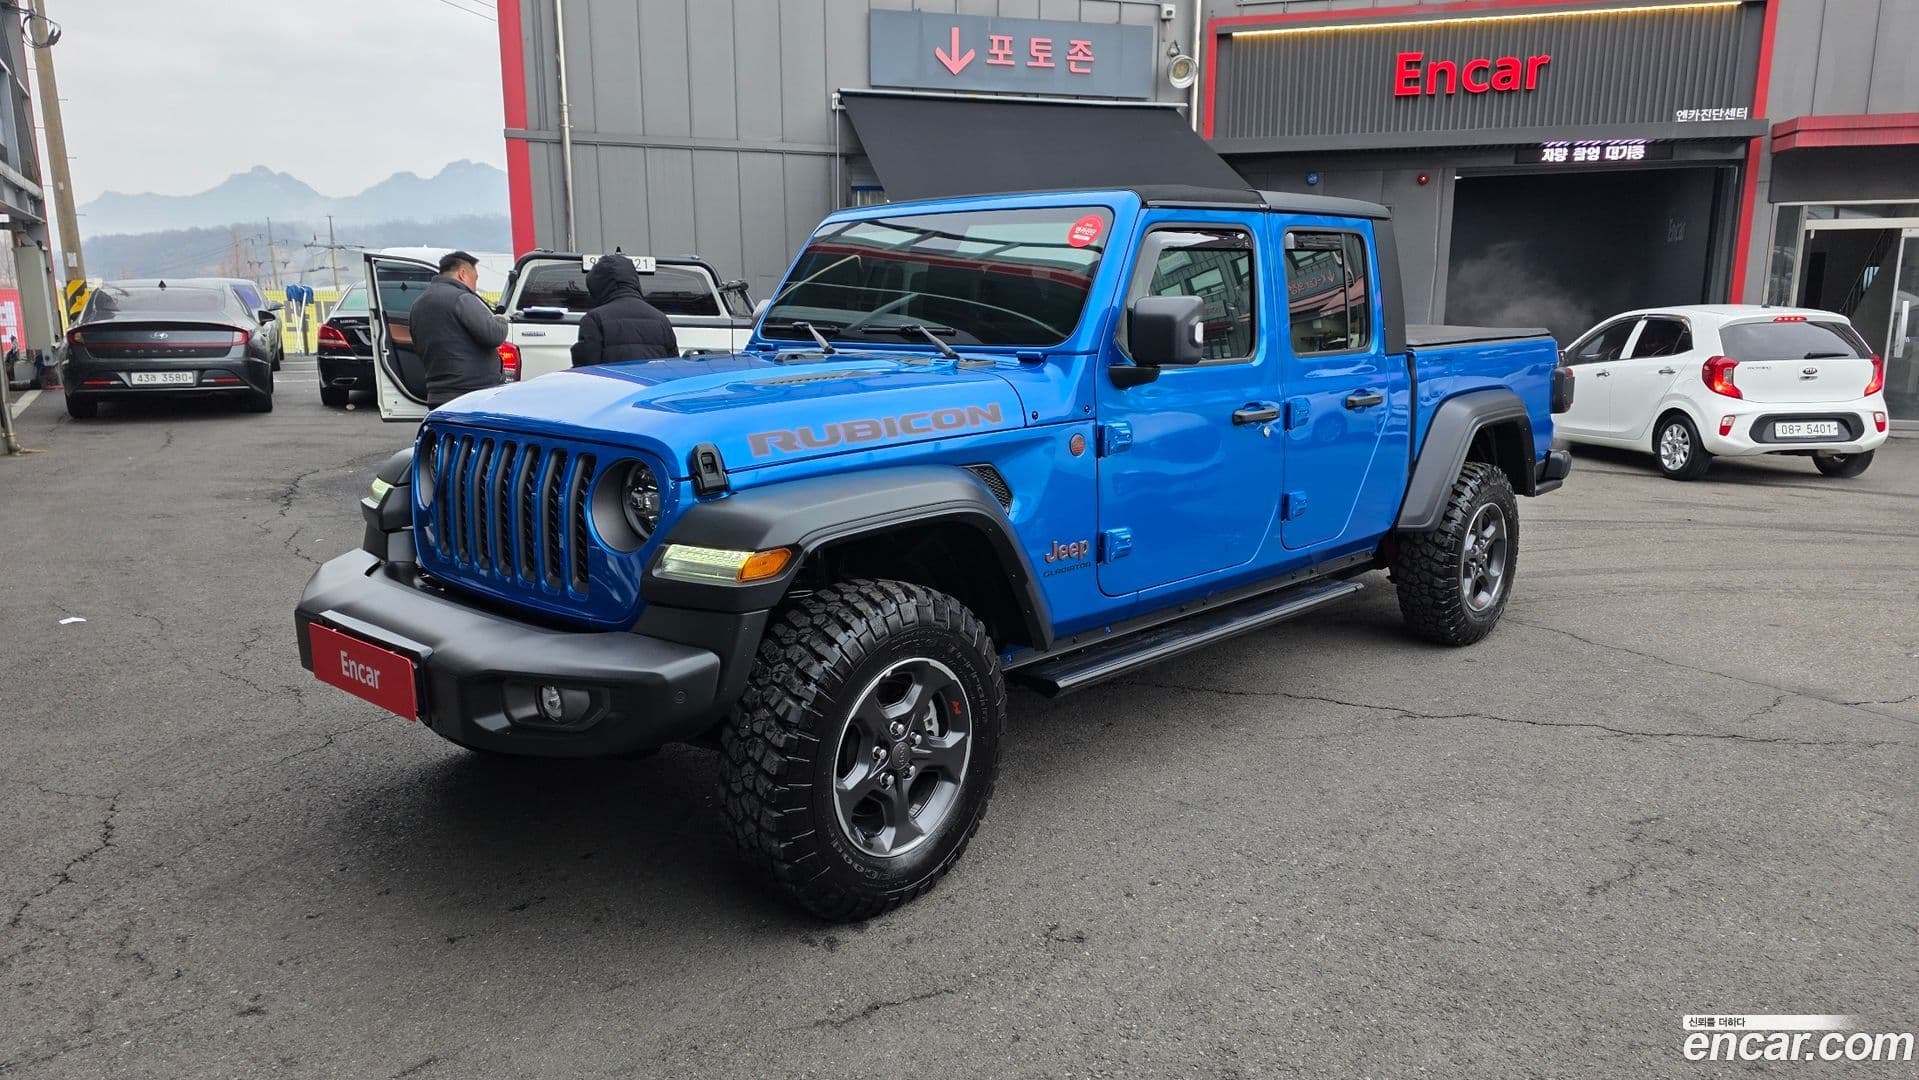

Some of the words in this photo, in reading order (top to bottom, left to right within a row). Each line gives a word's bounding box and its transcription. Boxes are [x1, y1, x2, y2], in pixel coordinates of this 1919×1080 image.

[986, 34, 1095, 74] 포토존
[1394, 52, 1551, 96] Encar
[1676, 107, 1748, 122] 엔카진단센터
[162, 373, 188, 382] 3580
[748, 403, 1002, 457] RUBICON
[1806, 423, 1831, 434] 5401
[1045, 539, 1089, 564] Jeep
[1043, 561, 1091, 577] GLADIATOR
[340, 649, 380, 689] Encar
